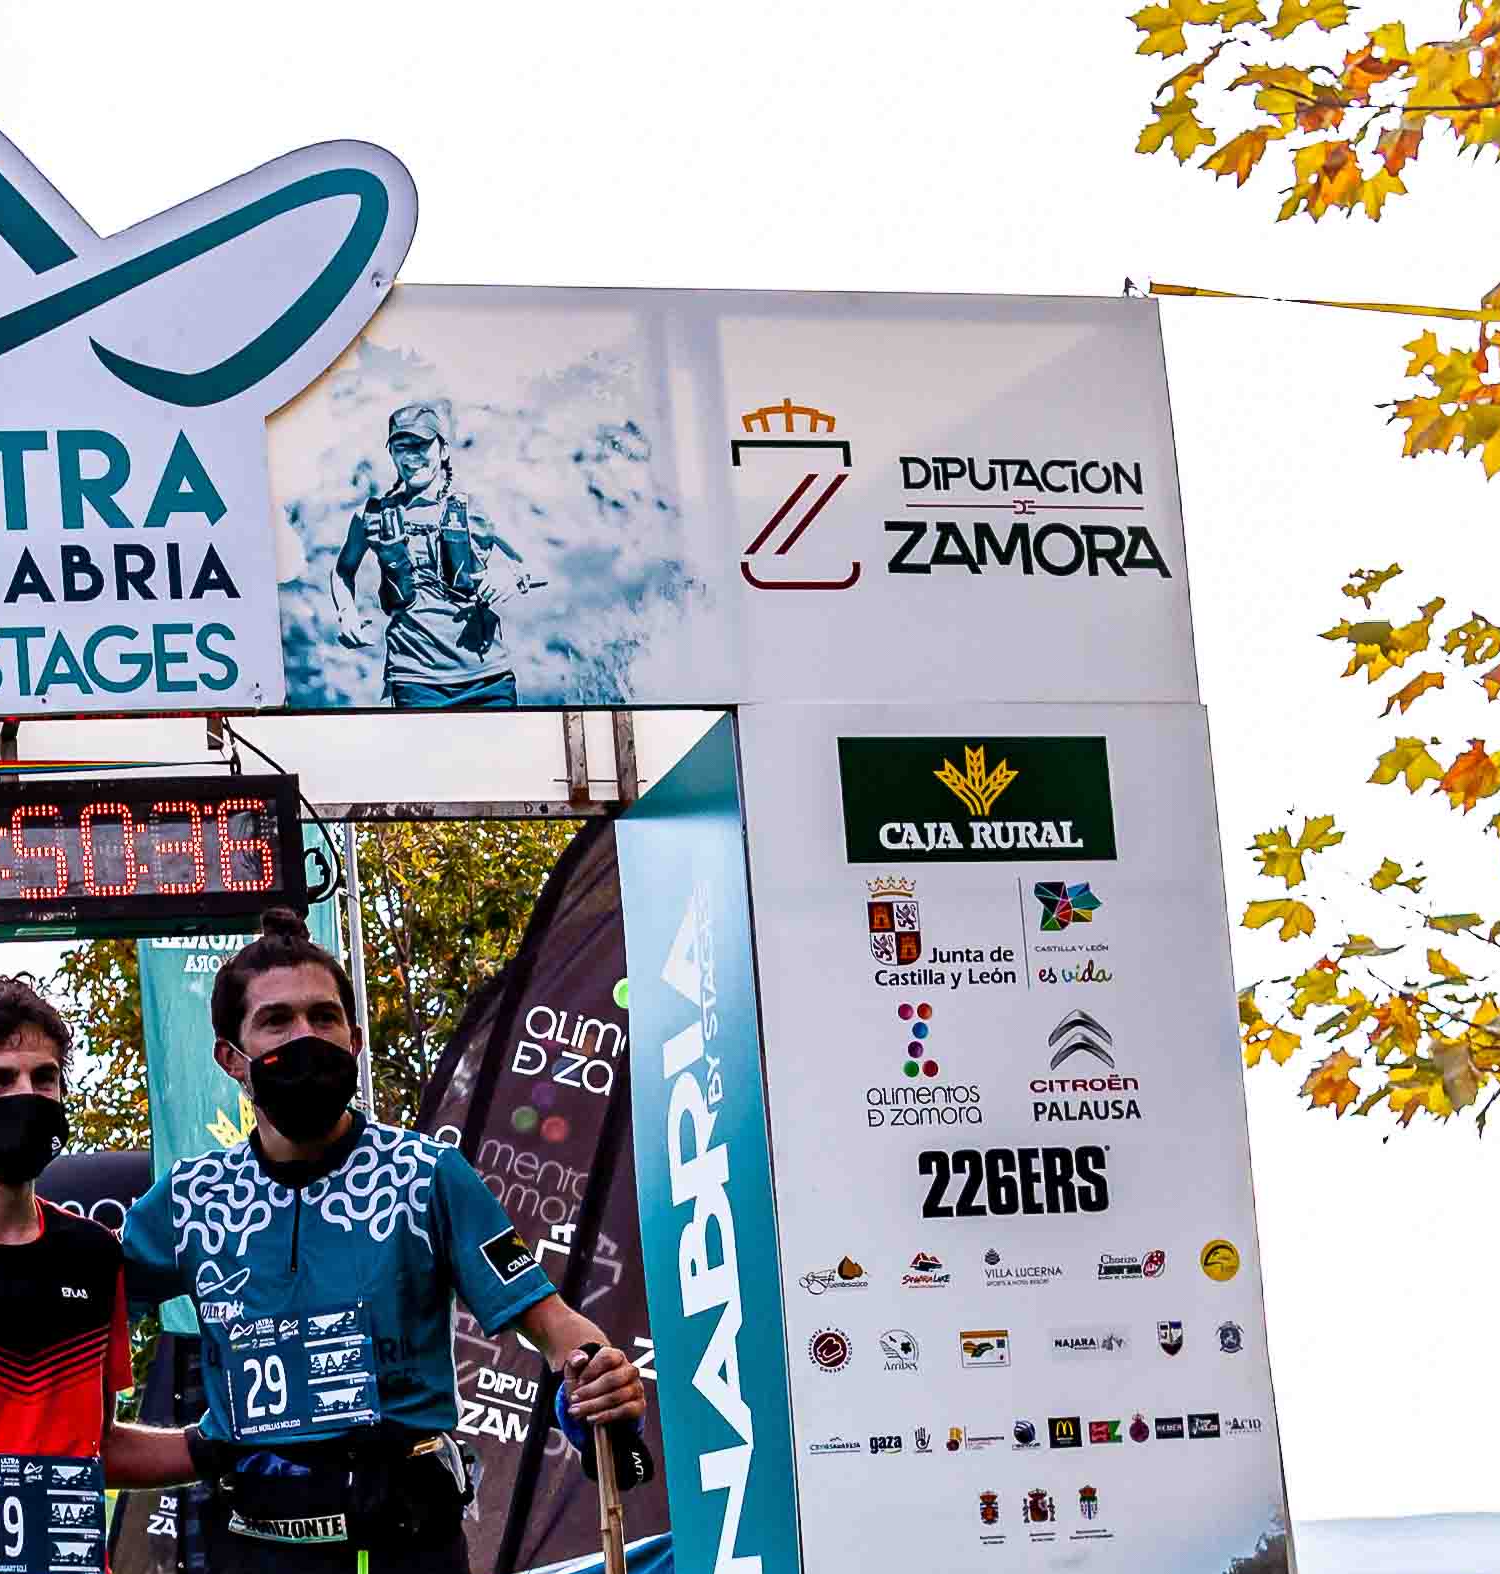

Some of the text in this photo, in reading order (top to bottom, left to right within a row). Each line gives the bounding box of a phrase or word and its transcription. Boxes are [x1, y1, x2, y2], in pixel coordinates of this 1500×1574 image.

[884, 520, 1172, 579] ZAMORA
[879, 820, 1084, 851] CAJA RURAL
[928, 946, 1015, 965] Junta de
[1034, 945, 1076, 953] CASTILLA
[874, 967, 1017, 990] Castilla y León
[1038, 959, 1113, 984] es vida
[1029, 1074, 1140, 1093] CITROËN
[866, 1084, 981, 1106] alimentos
[890, 1105, 982, 1126] zamora
[1033, 1100, 1142, 1122] PALAUSA
[918, 1145, 1110, 1219] 226ERS
[984, 1266, 1063, 1279] VILLA LUCERNA
[243, 1354, 287, 1418] 29
[869, 1435, 903, 1454] gaza
